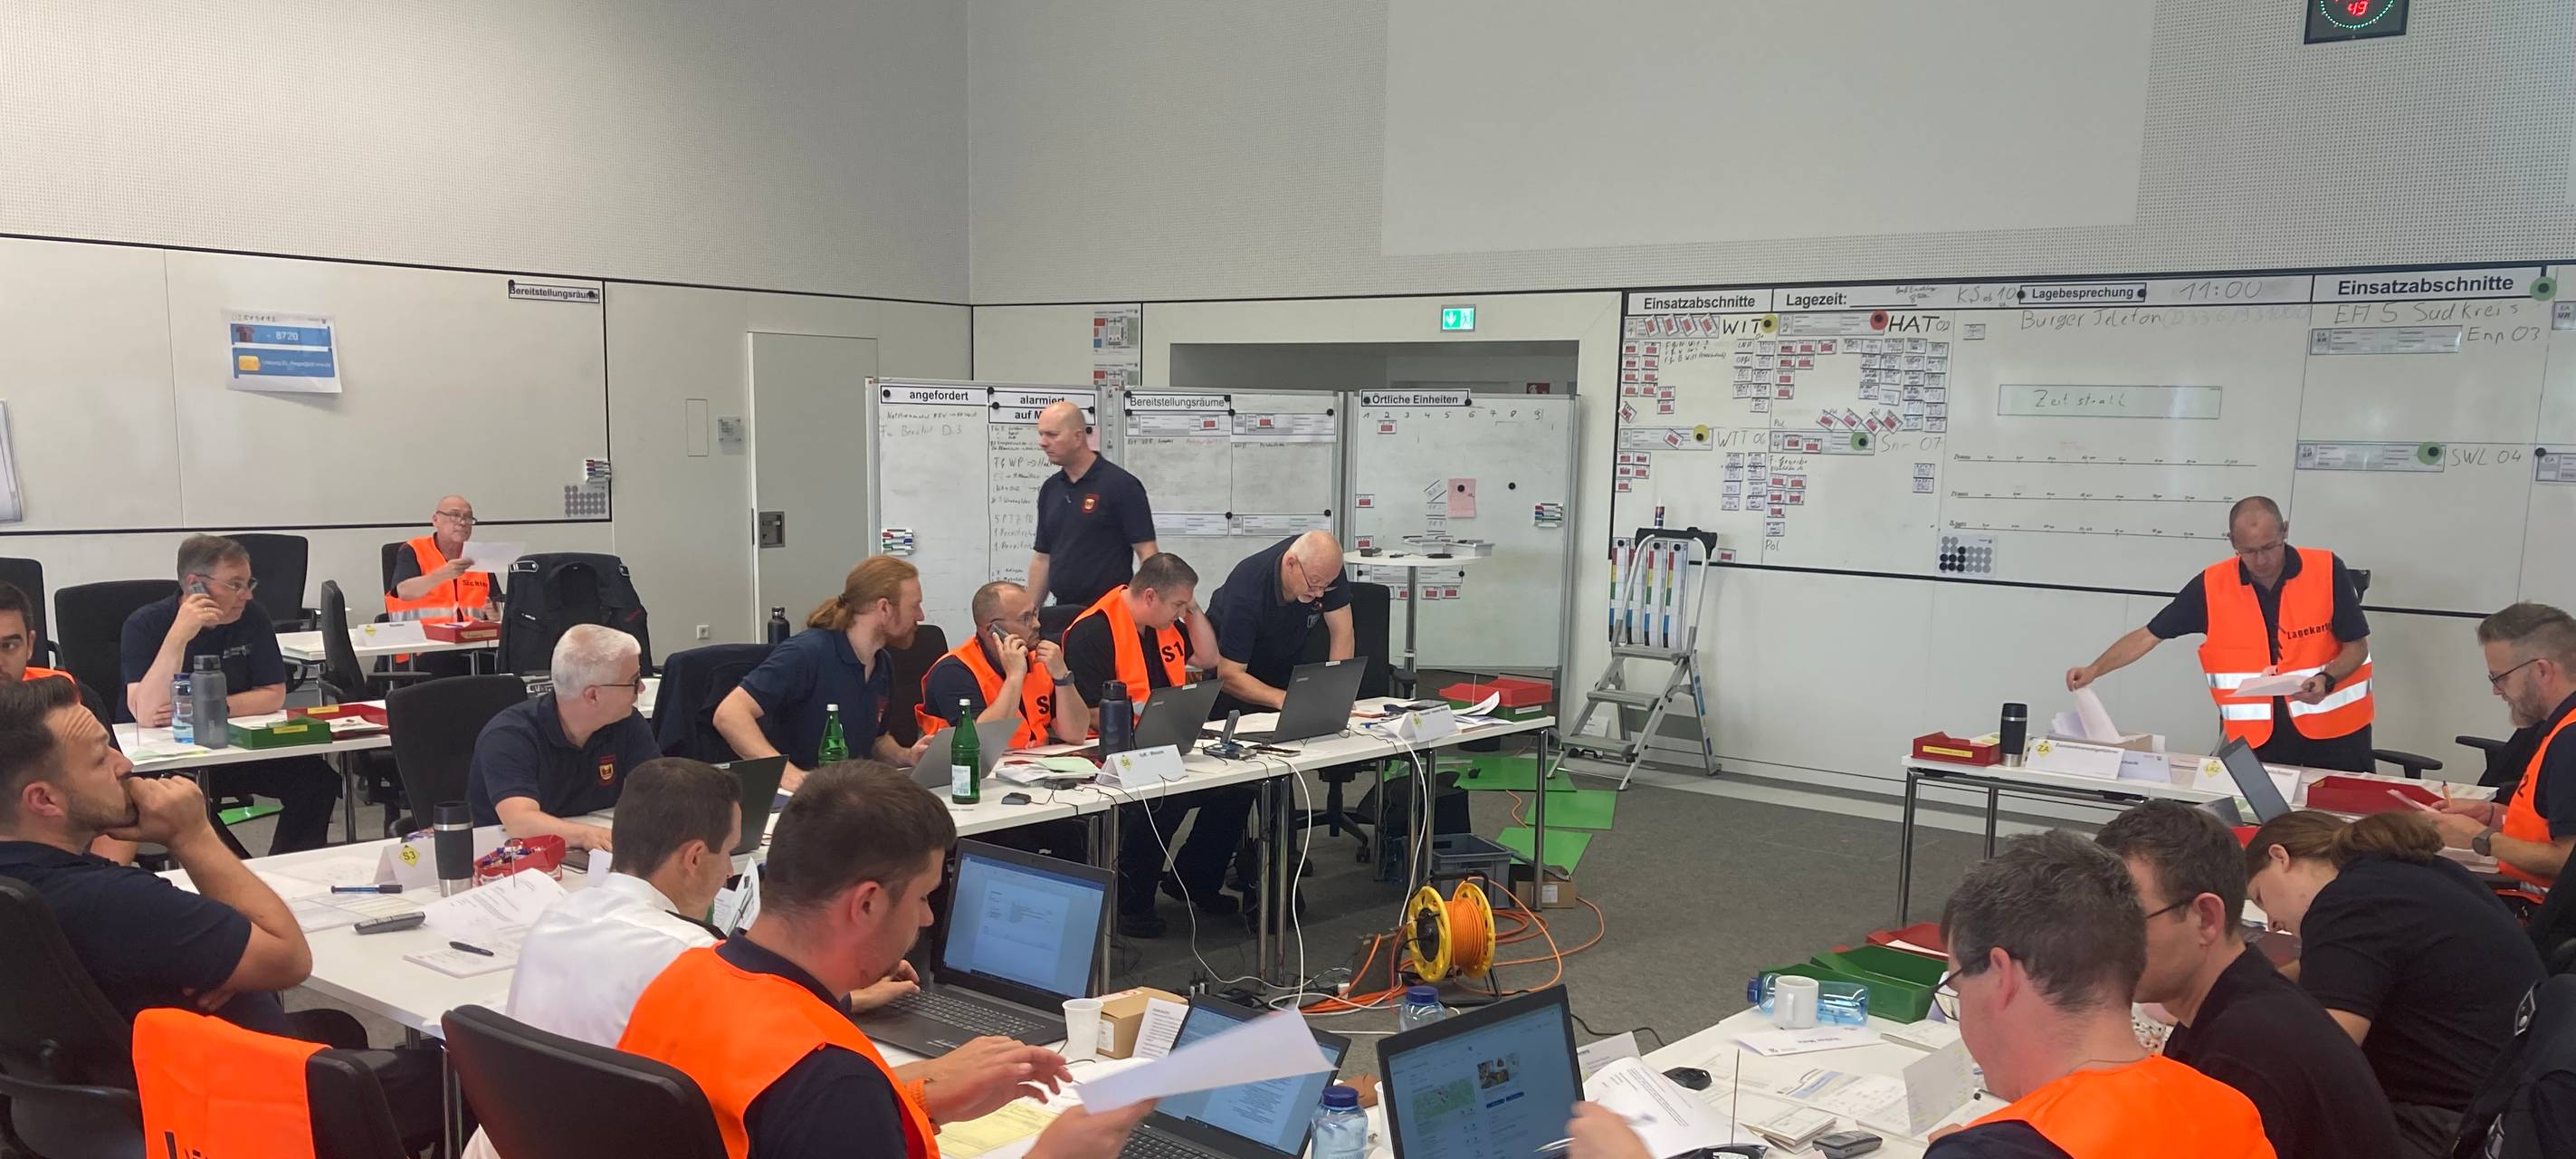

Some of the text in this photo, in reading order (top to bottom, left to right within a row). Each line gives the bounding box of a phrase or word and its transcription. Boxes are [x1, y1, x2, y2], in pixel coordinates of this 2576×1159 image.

[2180, 283, 2263, 302] 11:00
[2338, 275, 2514, 296] Einsatzabschnitte
[1787, 293, 1847, 310] Lagezeit:
[2032, 287, 2133, 302] Lagebesprechung
[1644, 295, 1755, 311] Einsatzabschnitte
[1888, 314, 1940, 333] HAT
[910, 390, 968, 403] angefordert
[1130, 397, 1226, 409] Bereitstellungsräume
[1372, 394, 1458, 405] Örtliche Einheiten
[1015, 409, 1031, 420] auf
[1384, 410, 1390, 419] 2
[1425, 411, 1430, 419] 4
[1468, 411, 1475, 419] 6
[1161, 641, 1184, 663] S1
[403, 851, 416, 861] S3
